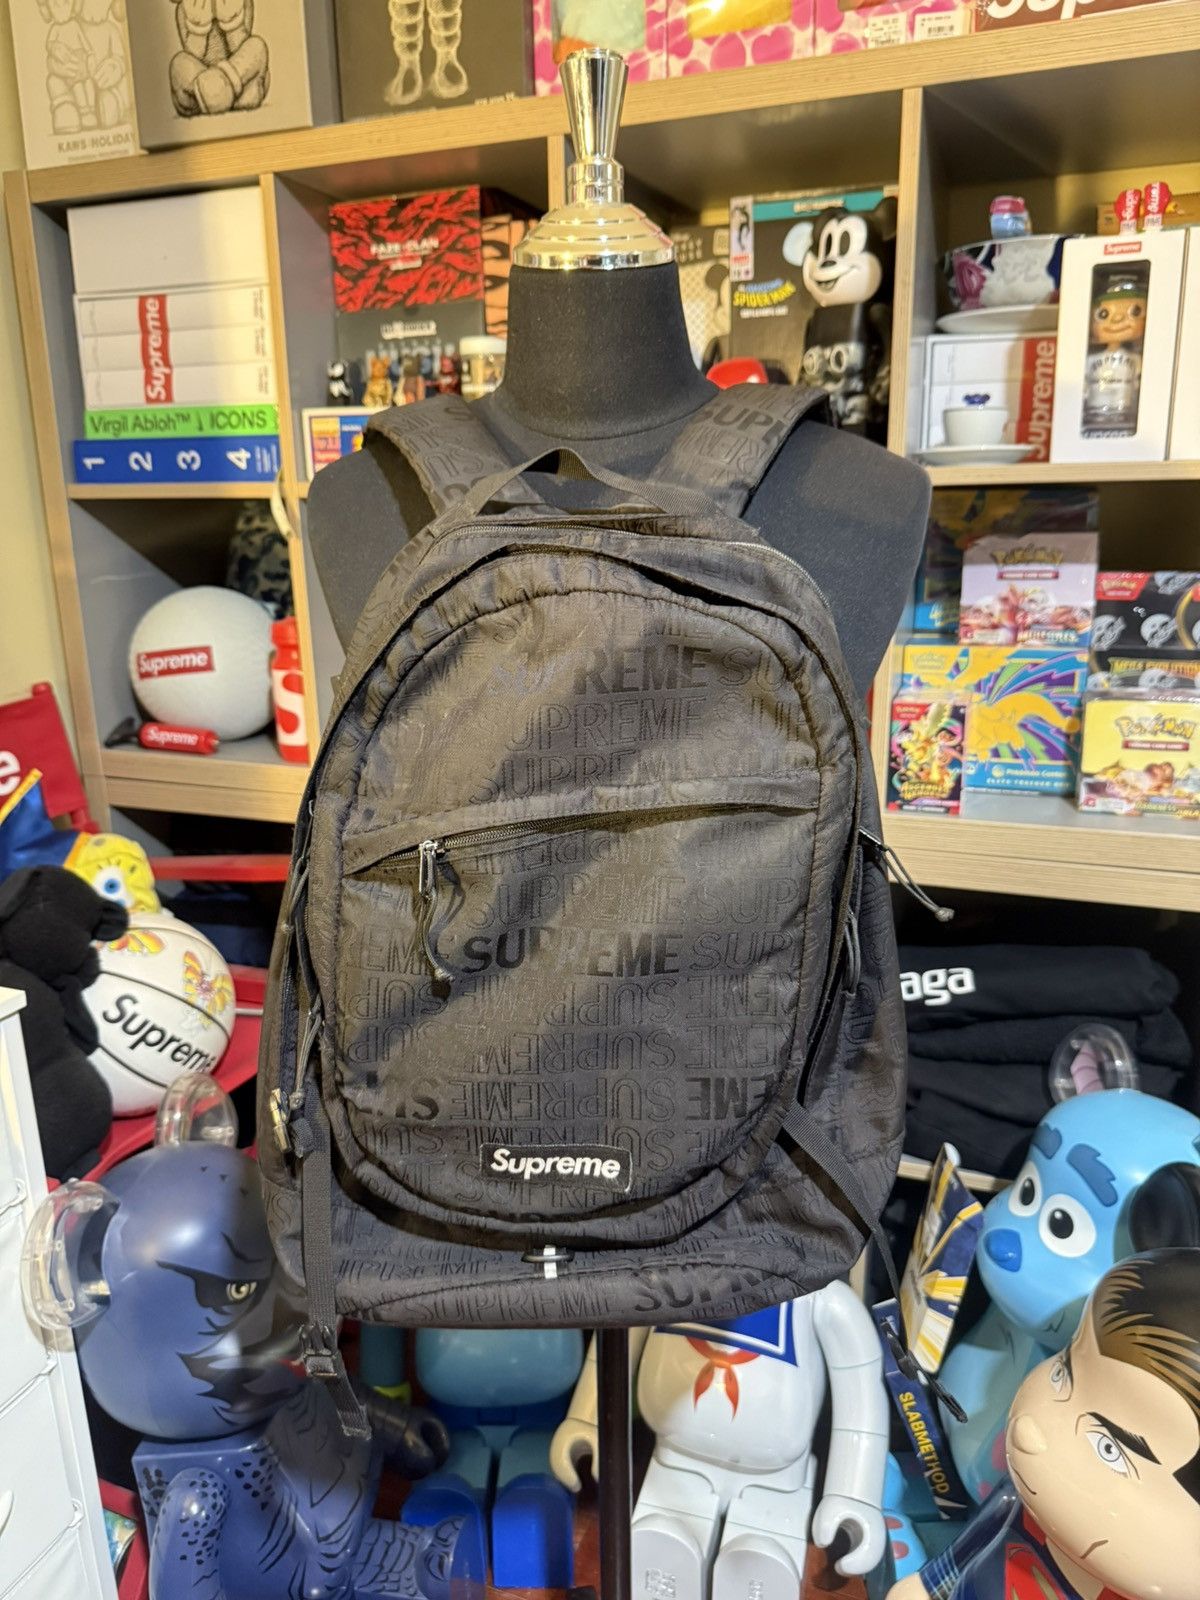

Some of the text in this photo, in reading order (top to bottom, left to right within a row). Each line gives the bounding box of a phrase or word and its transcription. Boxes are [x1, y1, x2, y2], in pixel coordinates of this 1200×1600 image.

[145, 297, 171, 401] Supreme
[90, 415, 128, 437] Virgil
[209, 410, 268, 431] ICONS
[83, 457, 105, 470] 1
[128, 451, 152, 471] 2
[176, 449, 201, 470] 3
[226, 447, 251, 470] 4
[138, 650, 208, 676] Supreme
[146, 725, 198, 746] Supreme
[464, 928, 684, 978] SUPREME
[900, 967, 976, 1006] aga
[102, 994, 216, 1073] Suprem
[457, 1028, 677, 1076] SUPREM
[490, 1148, 621, 1181] Supreme
[898, 1391, 950, 1494] SLABMETHOD
